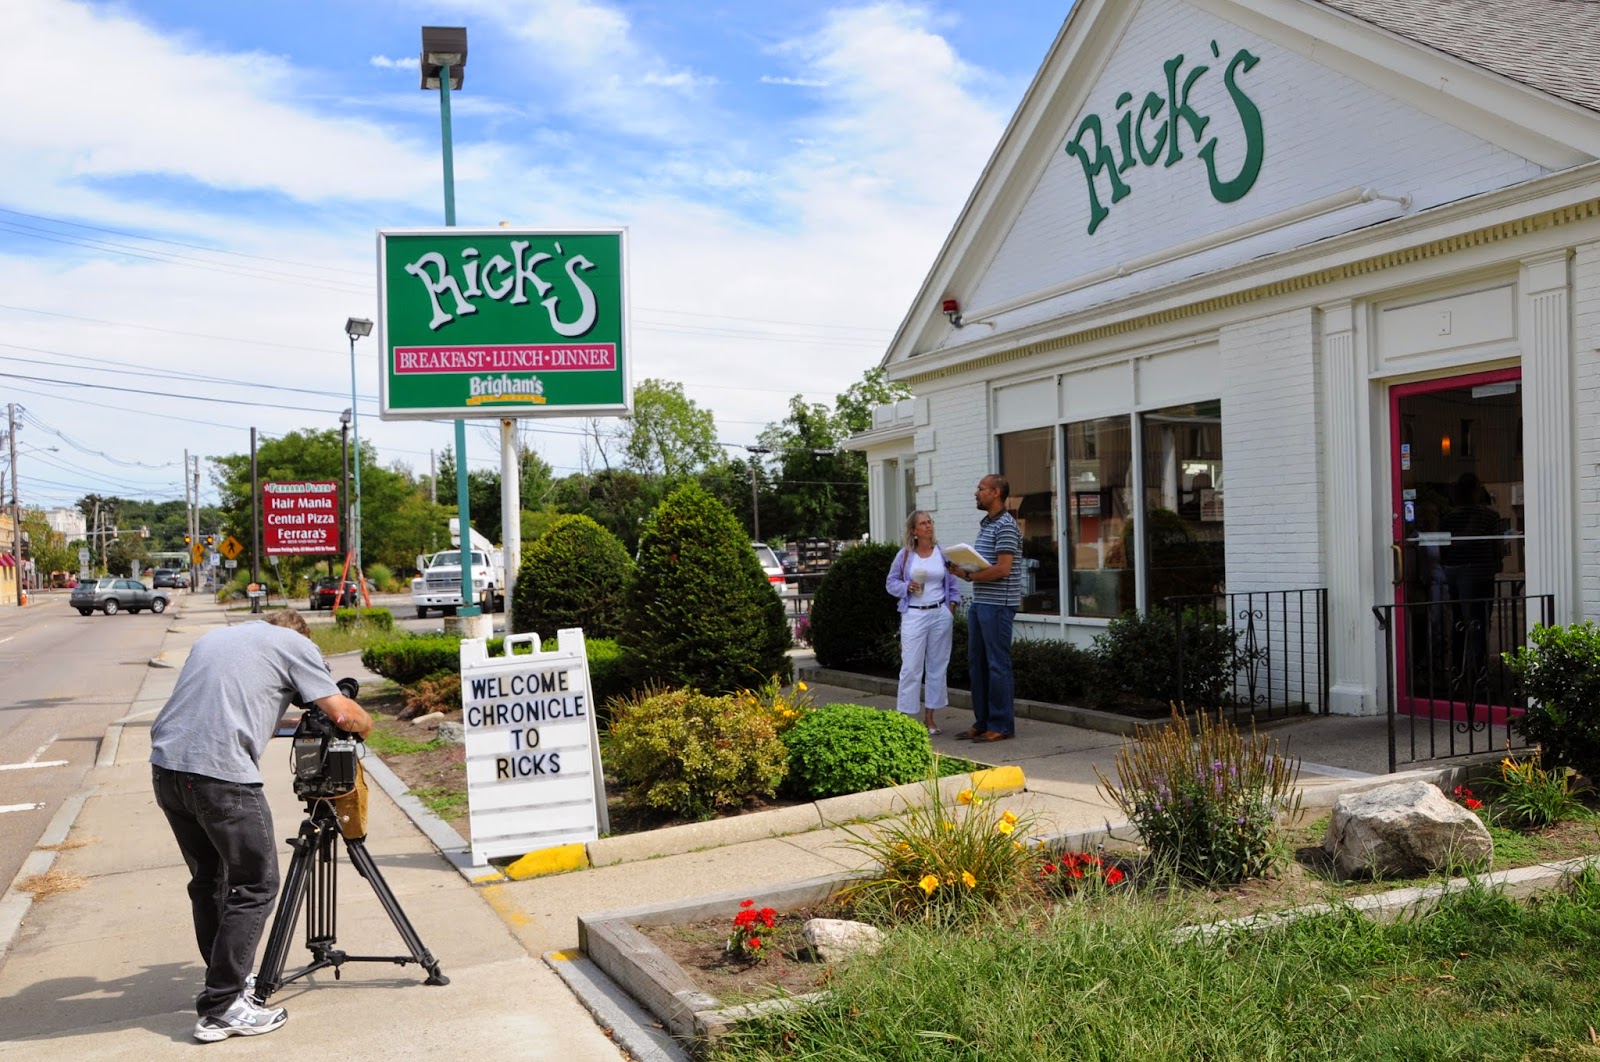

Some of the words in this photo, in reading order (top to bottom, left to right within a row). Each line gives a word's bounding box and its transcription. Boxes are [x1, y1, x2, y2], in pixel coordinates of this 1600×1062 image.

[400, 350, 486, 369] BREAKFAST
[493, 349, 544, 367] LUNCH
[551, 348, 611, 366] DINNER
[469, 373, 544, 398] Brigham's
[271, 498, 295, 509] Hair
[298, 497, 332, 509] Mania
[267, 513, 305, 525] Central
[307, 513, 335, 524] Pizza
[277, 528, 327, 539] Ferrara's
[471, 670, 569, 700] WELCOME
[468, 695, 586, 728] CHRONICLE
[510, 727, 540, 750] TO
[496, 752, 561, 780] RICKS
